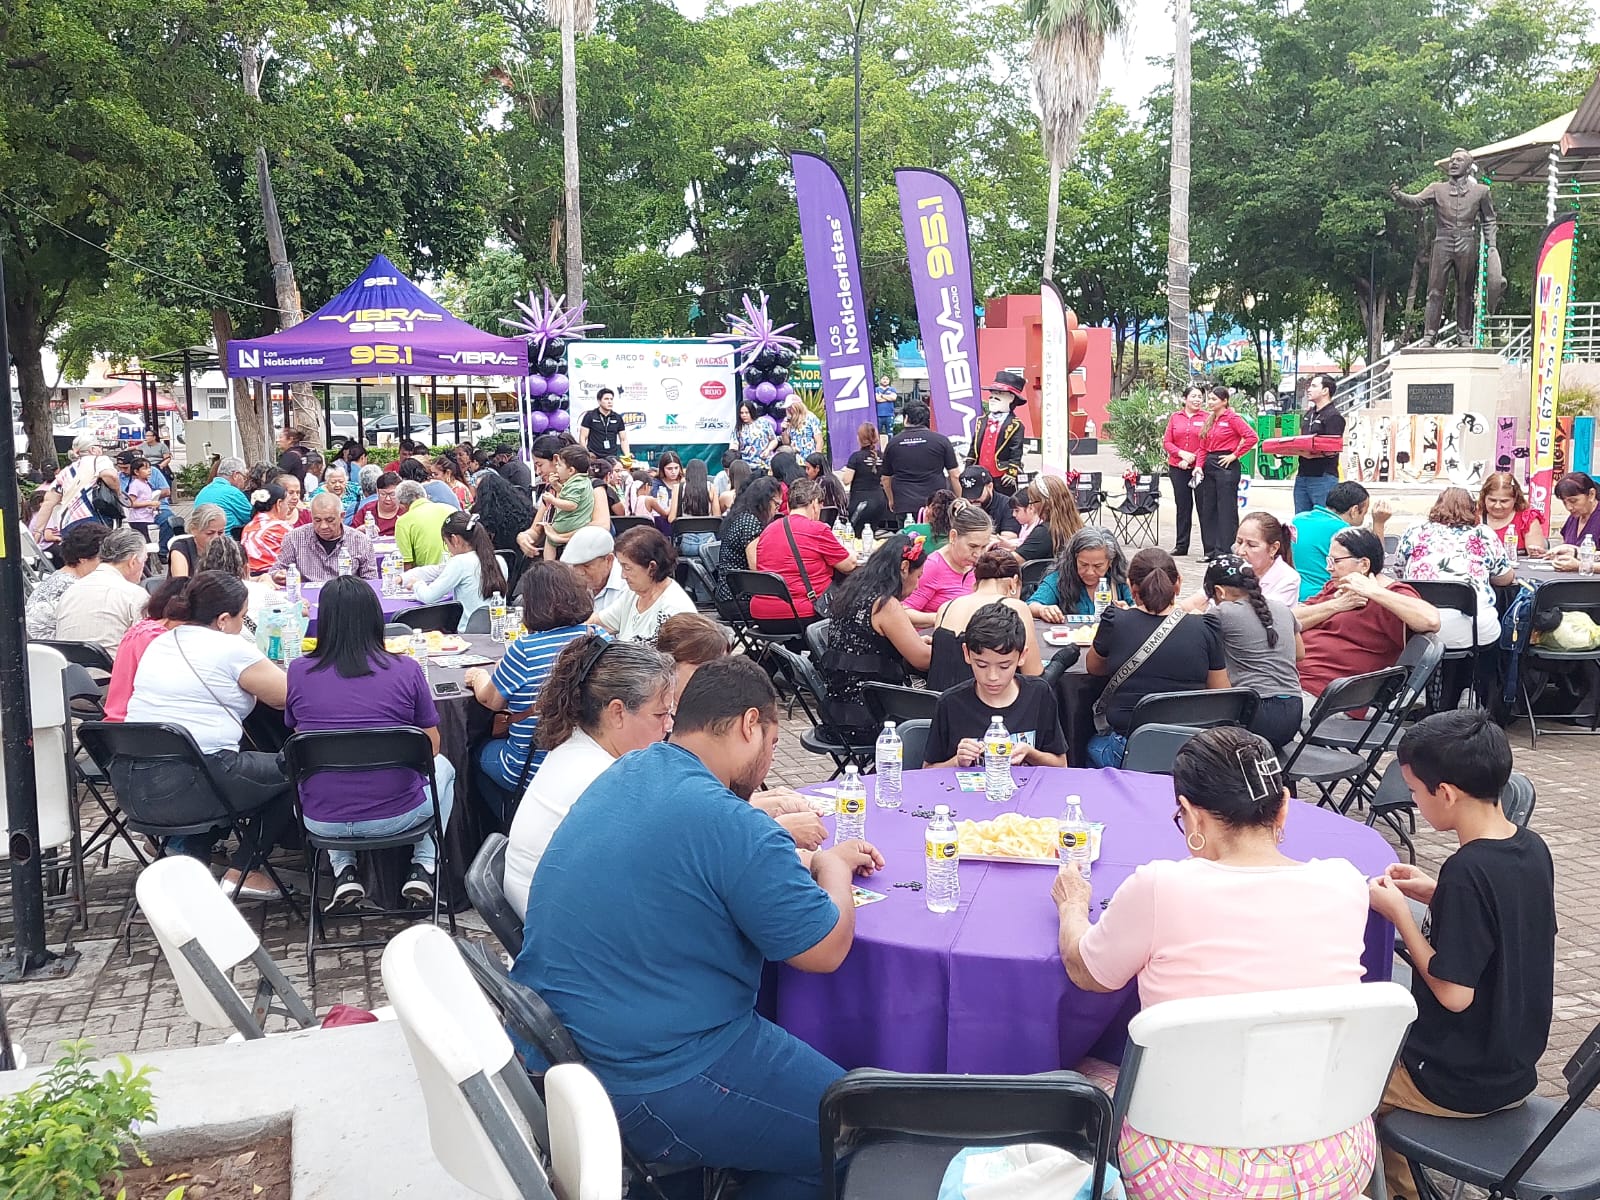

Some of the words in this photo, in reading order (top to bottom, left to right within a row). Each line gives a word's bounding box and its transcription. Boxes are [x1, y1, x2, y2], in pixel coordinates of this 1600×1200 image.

[917, 195, 955, 280] 95.1
[363, 277, 398, 287] 95.1
[832, 218, 860, 355] Noticieristas
[953, 285, 962, 319] RADIO
[318, 308, 443, 323] VIBRA
[348, 321, 414, 333] 95.1
[350, 345, 414, 365] 95.1
[439, 352, 518, 365] VIBRA
[936, 288, 977, 442] VIBRA
